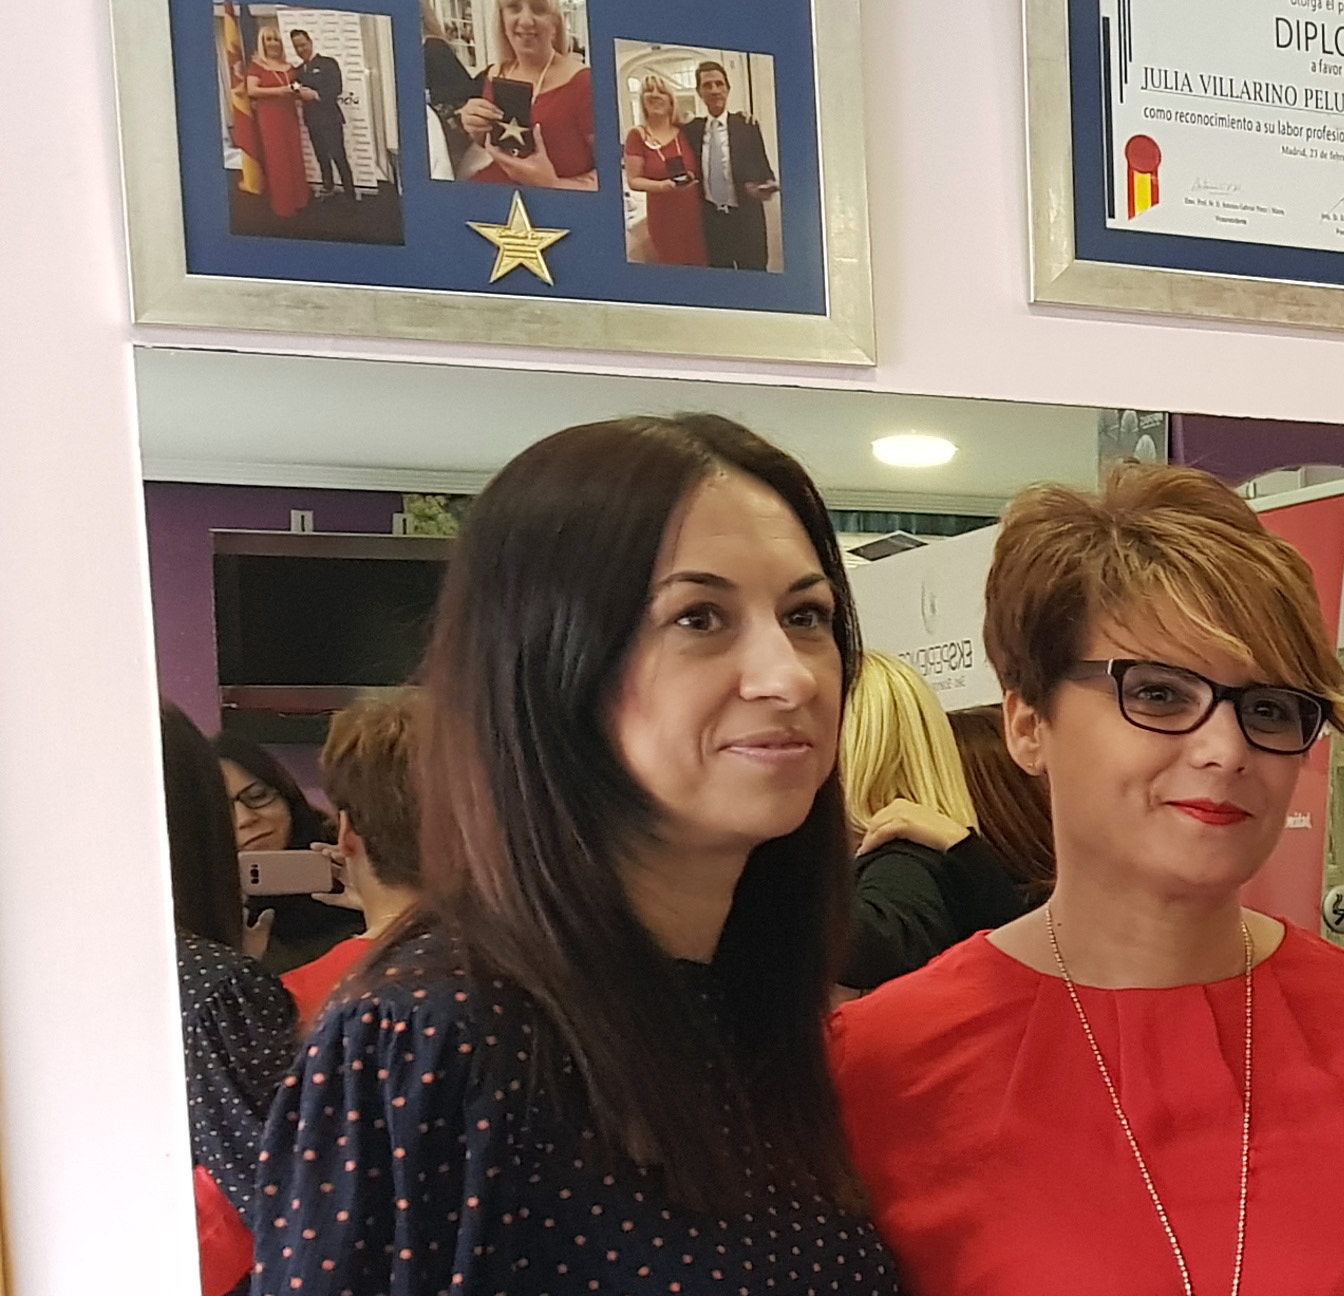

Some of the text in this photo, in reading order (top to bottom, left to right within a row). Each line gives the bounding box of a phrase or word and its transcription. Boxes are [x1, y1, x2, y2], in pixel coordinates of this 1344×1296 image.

[1311, 62, 1317, 73] a
[1318, 58, 1343, 77] favor
[1141, 66, 1193, 93] JULIA
[1199, 74, 1298, 108] VILLARINO
[1143, 106, 1172, 122] como
[1174, 110, 1253, 132] reconocimiento
[1255, 121, 1262, 133] a
[1263, 122, 1275, 135] su
[1277, 121, 1303, 139] labor
